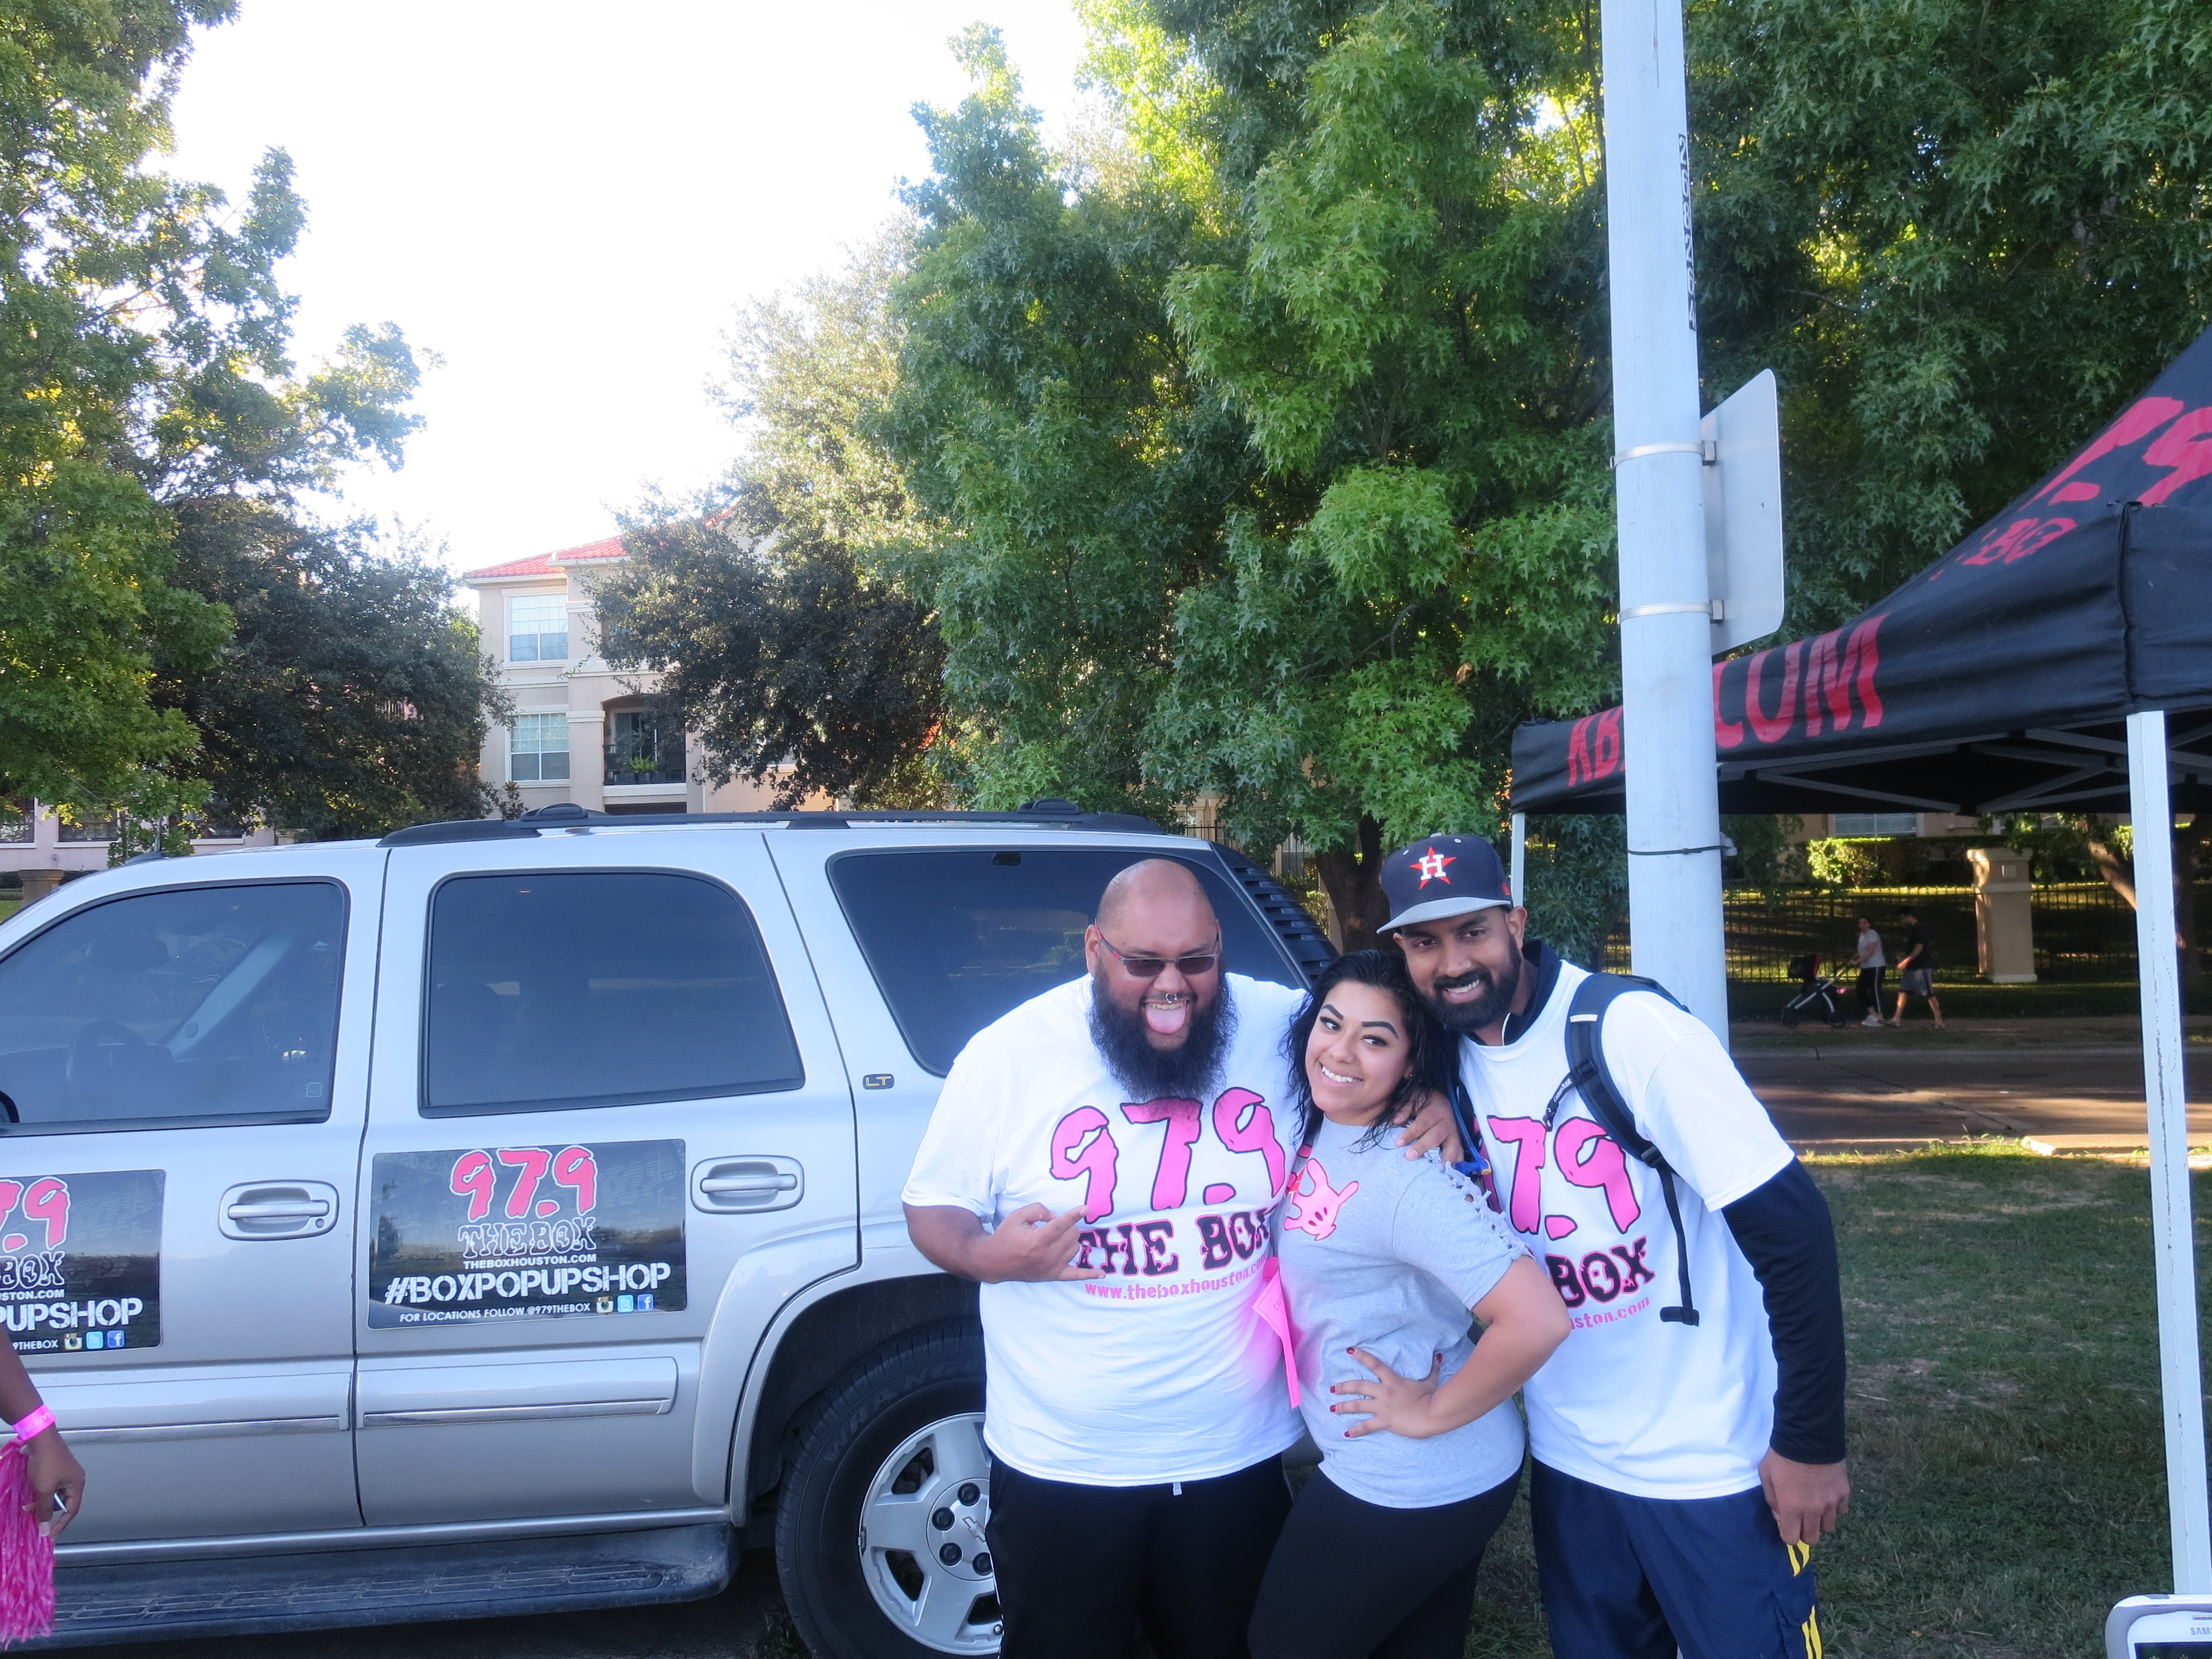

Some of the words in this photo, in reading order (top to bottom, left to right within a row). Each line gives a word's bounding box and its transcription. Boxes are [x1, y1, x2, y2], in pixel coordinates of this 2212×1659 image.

[1568, 705, 1625, 787] KB
[865, 1076, 891, 1087] LT
[1050, 1087, 1286, 1224] 97.9
[450, 1145, 597, 1222] 97.9
[1488, 1115, 1641, 1241] 7.9
[463, 1253, 597, 1270] THEBOXHOUSTON.COM
[1545, 1235, 1656, 1309] BOX
[0, 1289, 65, 1301] STON.COM
[385, 1262, 671, 1305] #BOXPOPUPSHOP
[399, 1312, 420, 1323] FOR
[422, 1310, 482, 1322] LOCATIONS
[483, 1307, 525, 1318] FOLLOW
[527, 1302, 591, 1316] @979THEBOX
[12, 1339, 60, 1351] 9THEBOX
[2190, 1627, 2212, 1635] SAM
